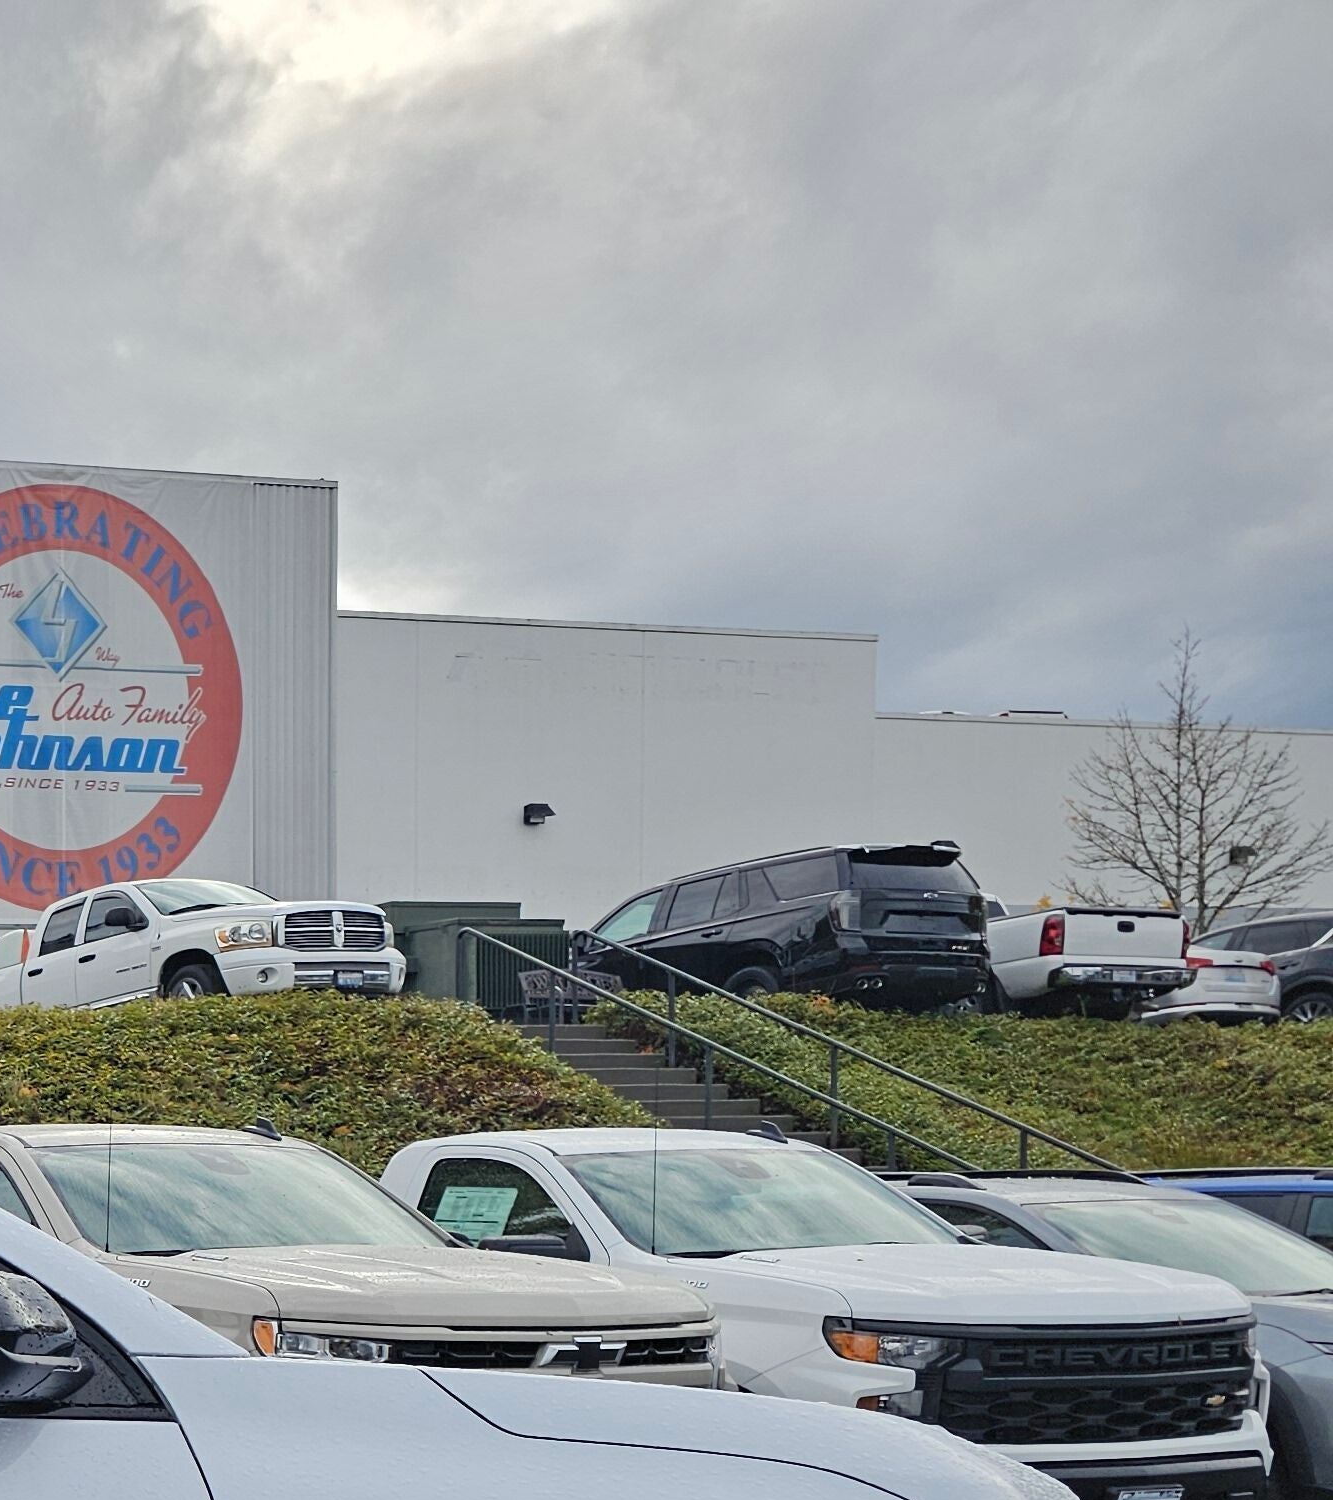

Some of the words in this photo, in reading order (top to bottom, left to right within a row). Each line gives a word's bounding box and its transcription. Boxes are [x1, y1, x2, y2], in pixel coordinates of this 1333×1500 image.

[0, 583, 25, 600] The
[96, 647, 121, 667] Way
[51, 683, 114, 722] Auto
[120, 686, 206, 741] Family
[4, 777, 64, 790] SINCE
[73, 780, 120, 792] 1933
[97, 817, 181, 885] 1933
[989, 1340, 1248, 1366] CHEVROLET
